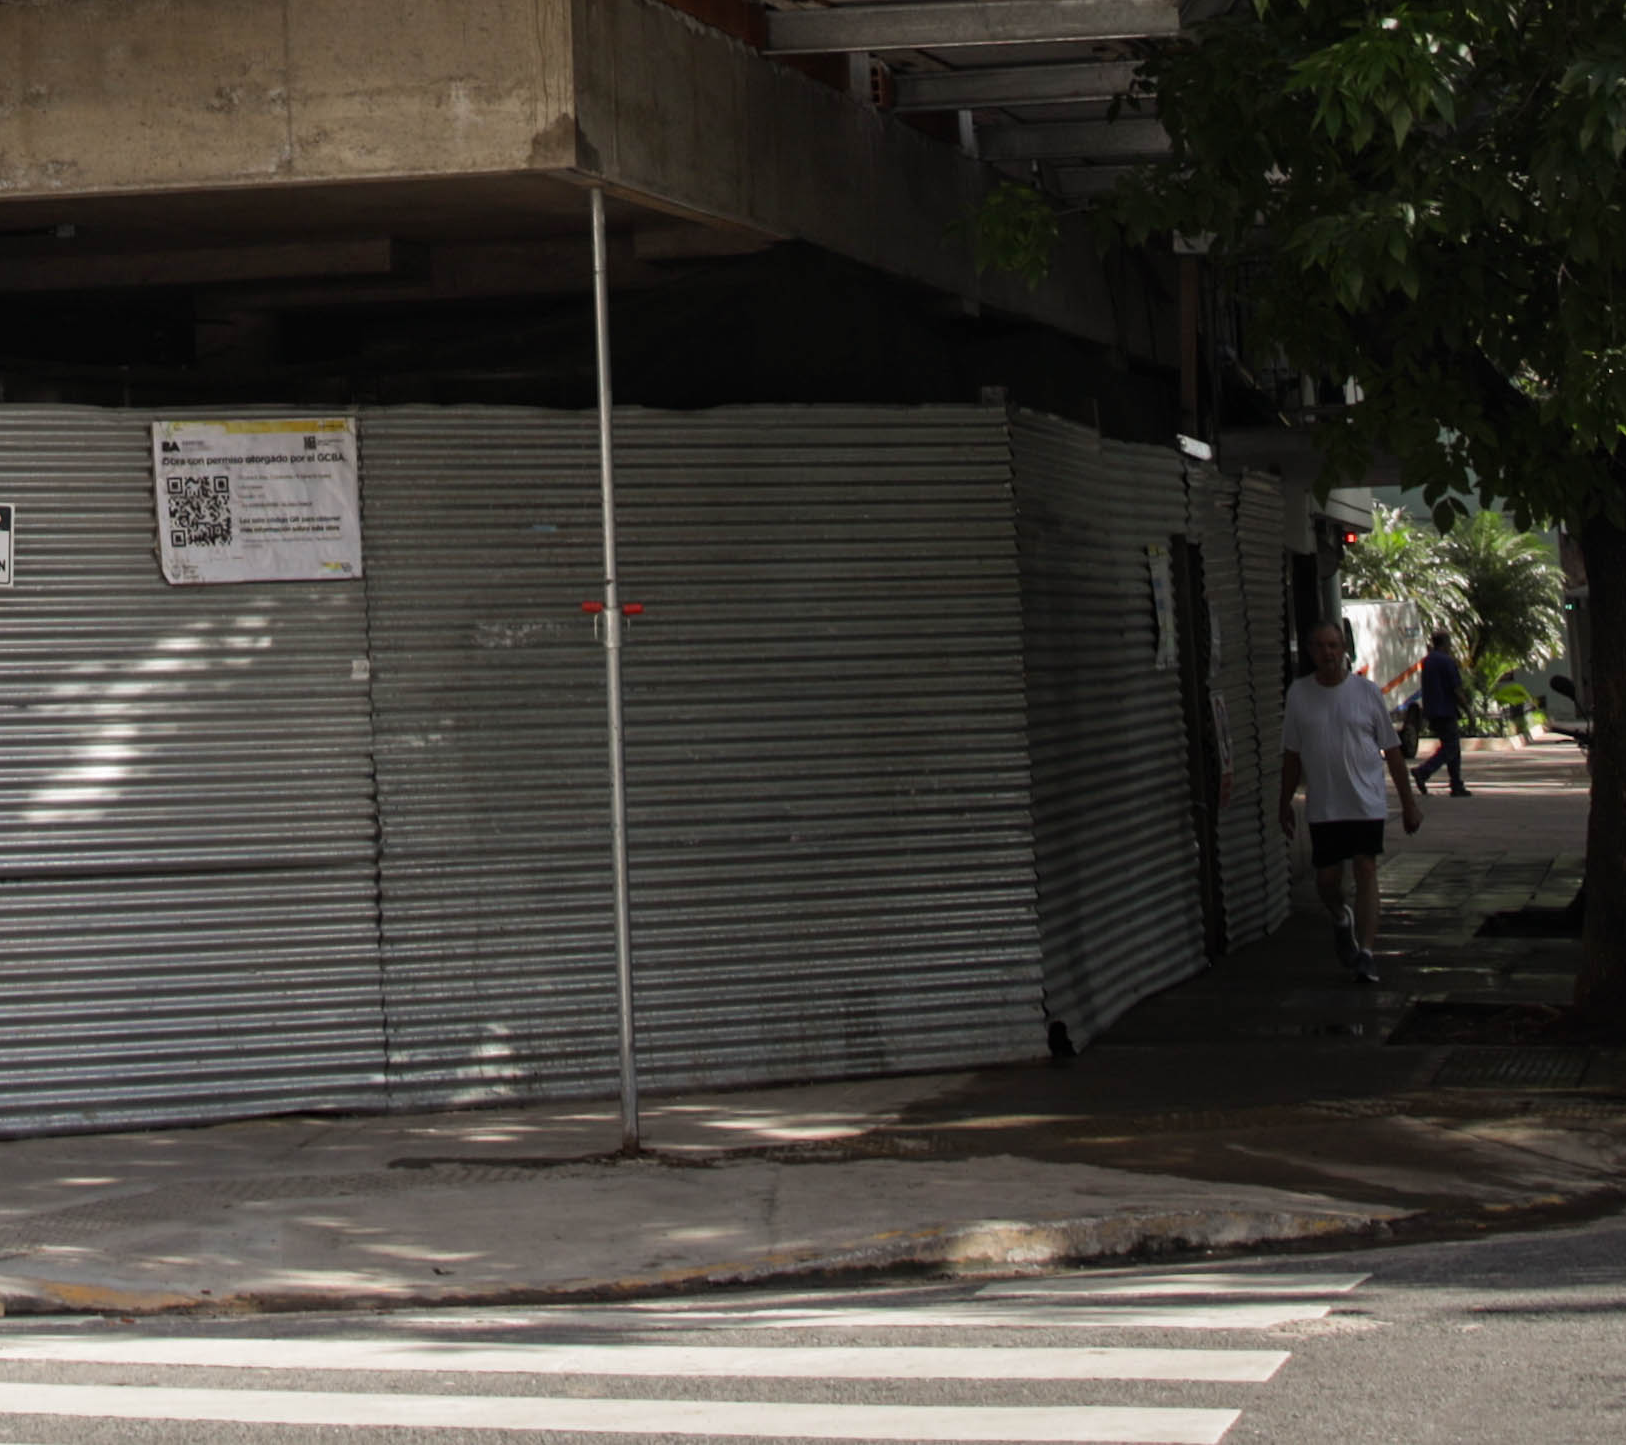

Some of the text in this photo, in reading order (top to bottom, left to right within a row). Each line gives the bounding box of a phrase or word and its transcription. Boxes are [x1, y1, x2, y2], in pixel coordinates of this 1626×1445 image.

[207, 456, 243, 466] permiso
[246, 455, 288, 465] otorgado
[291, 456, 305, 464] por
